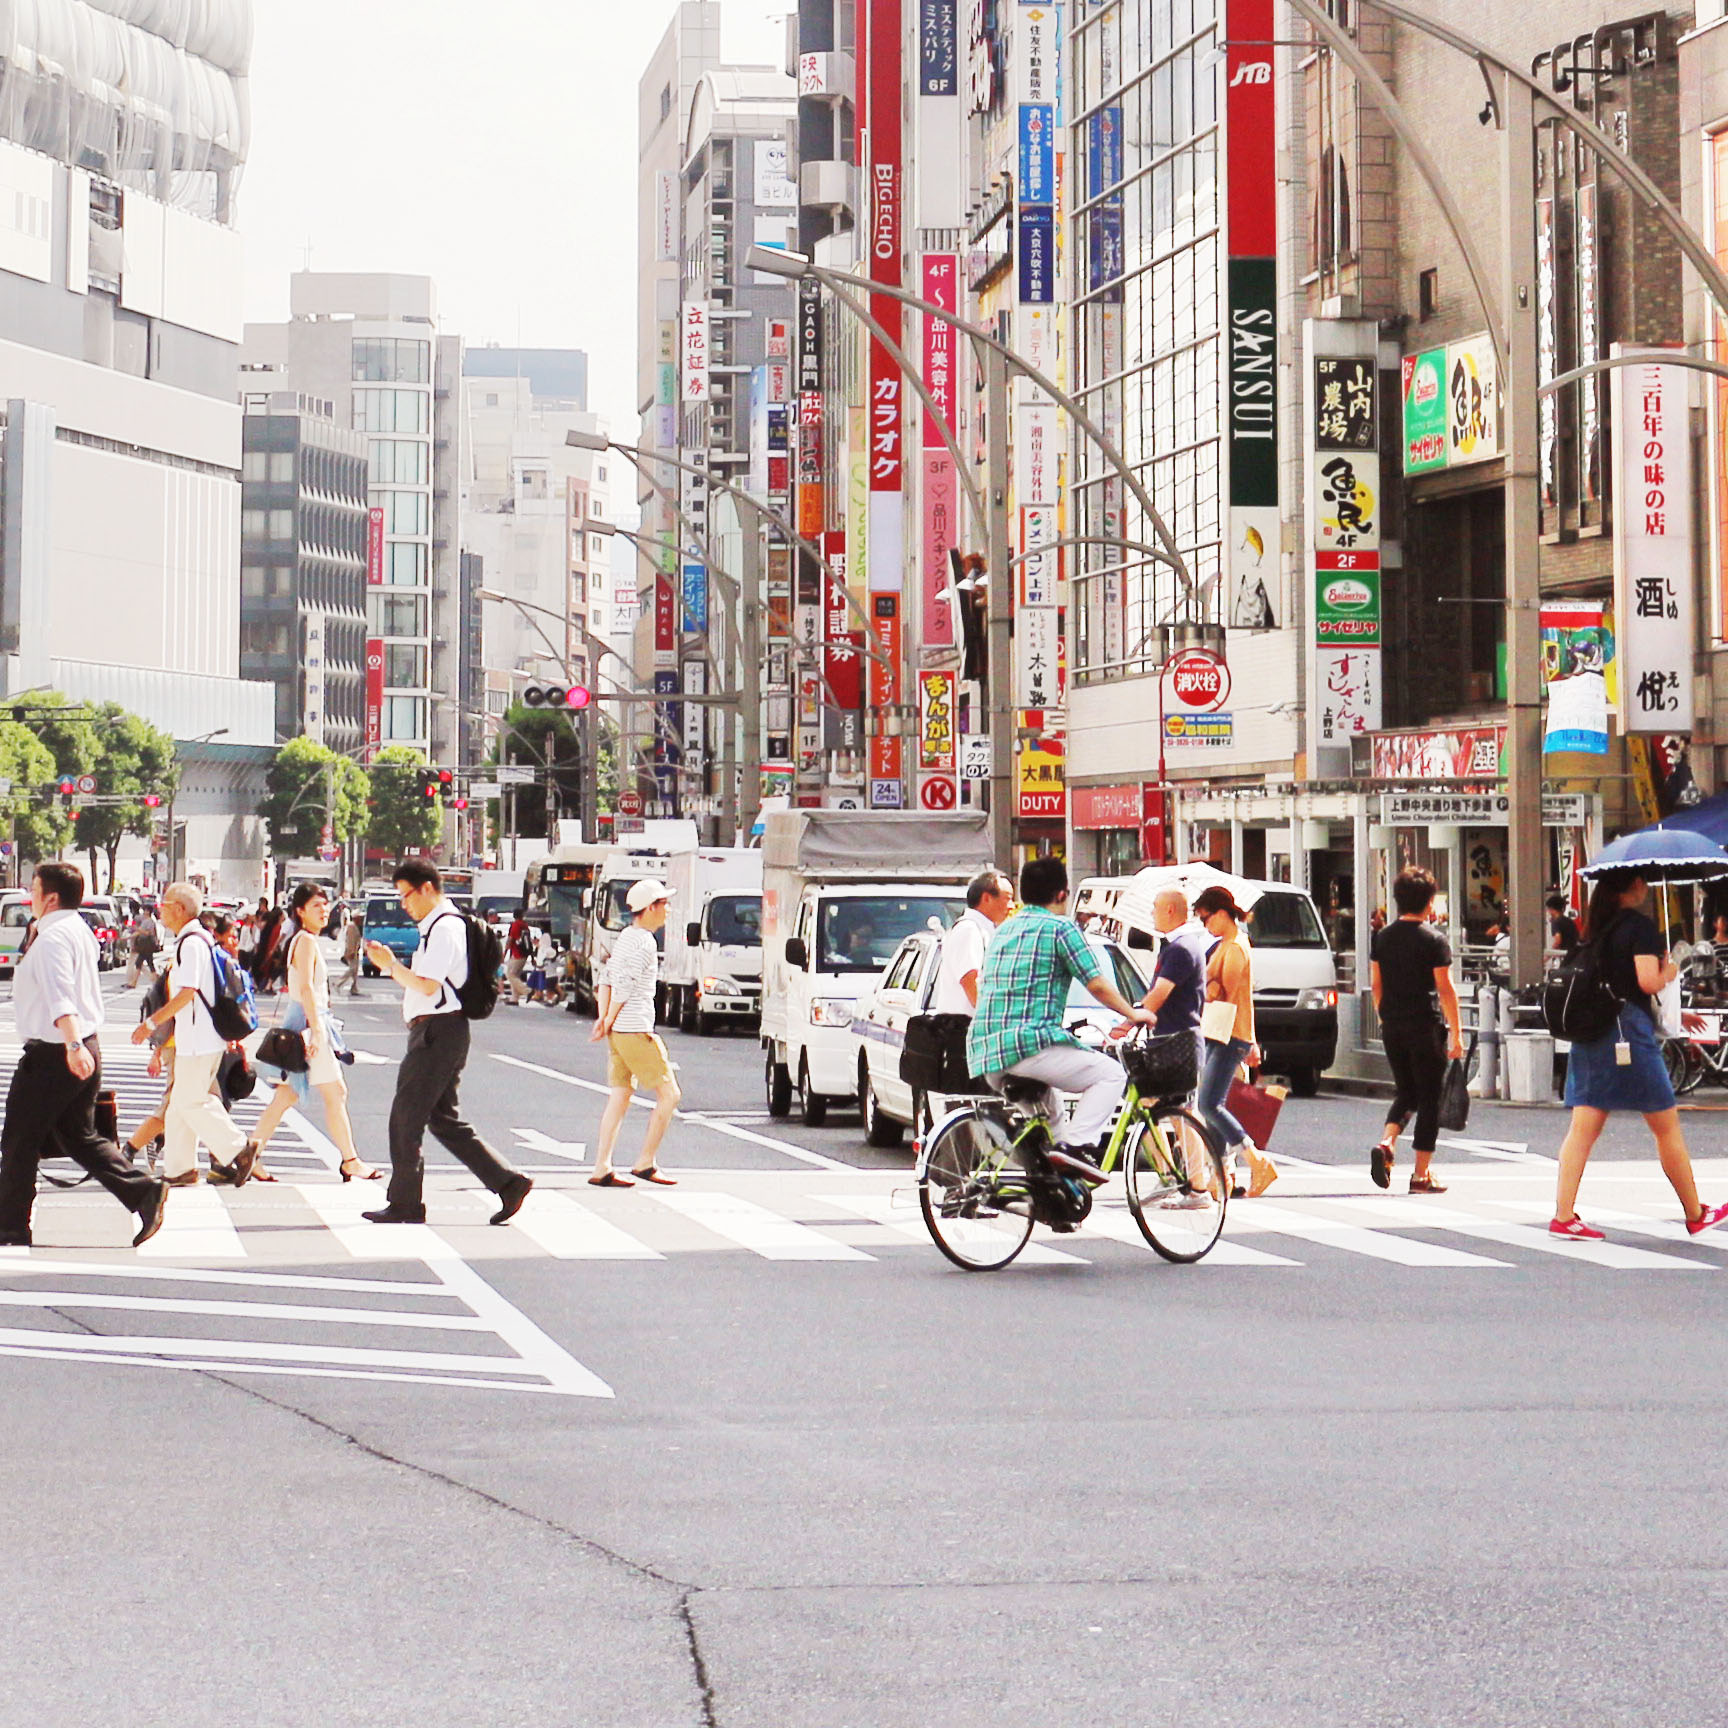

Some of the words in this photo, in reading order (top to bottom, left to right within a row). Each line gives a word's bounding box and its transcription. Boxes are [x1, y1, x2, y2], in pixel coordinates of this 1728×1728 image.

[1028, 24, 1042, 100] 住友不動産販売
[1229, 60, 1271, 87] JTB
[928, 78, 949, 91] 6F
[874, 163, 894, 197] BIG
[874, 200, 894, 259] ECHO
[928, 263, 949, 278] 4F
[1030, 227, 1043, 302] 大京穴吹不動産
[1233, 308, 1273, 441] SANSUI
[1319, 361, 1337, 373] 5F
[1346, 364, 1373, 420] 山内
[873, 377, 899, 479] カラオケ
[1319, 380, 1348, 443] 農場
[929, 460, 949, 474] 3F
[1641, 366, 1666, 536] 三百年の味の店
[1321, 457, 1374, 535] 魚民
[1336, 534, 1358, 548] 4F
[1337, 554, 1357, 568] 2F
[1317, 618, 1379, 637] サイゼリヤ
[1635, 578, 1666, 713] 酒悦
[1176, 672, 1218, 692] 消火栓
[925, 674, 949, 739] まんが
[1323, 706, 1334, 739] 上野店
[1022, 795, 1062, 812] DUTY
[1391, 798, 1493, 813] 上野中央通り地下歩道
